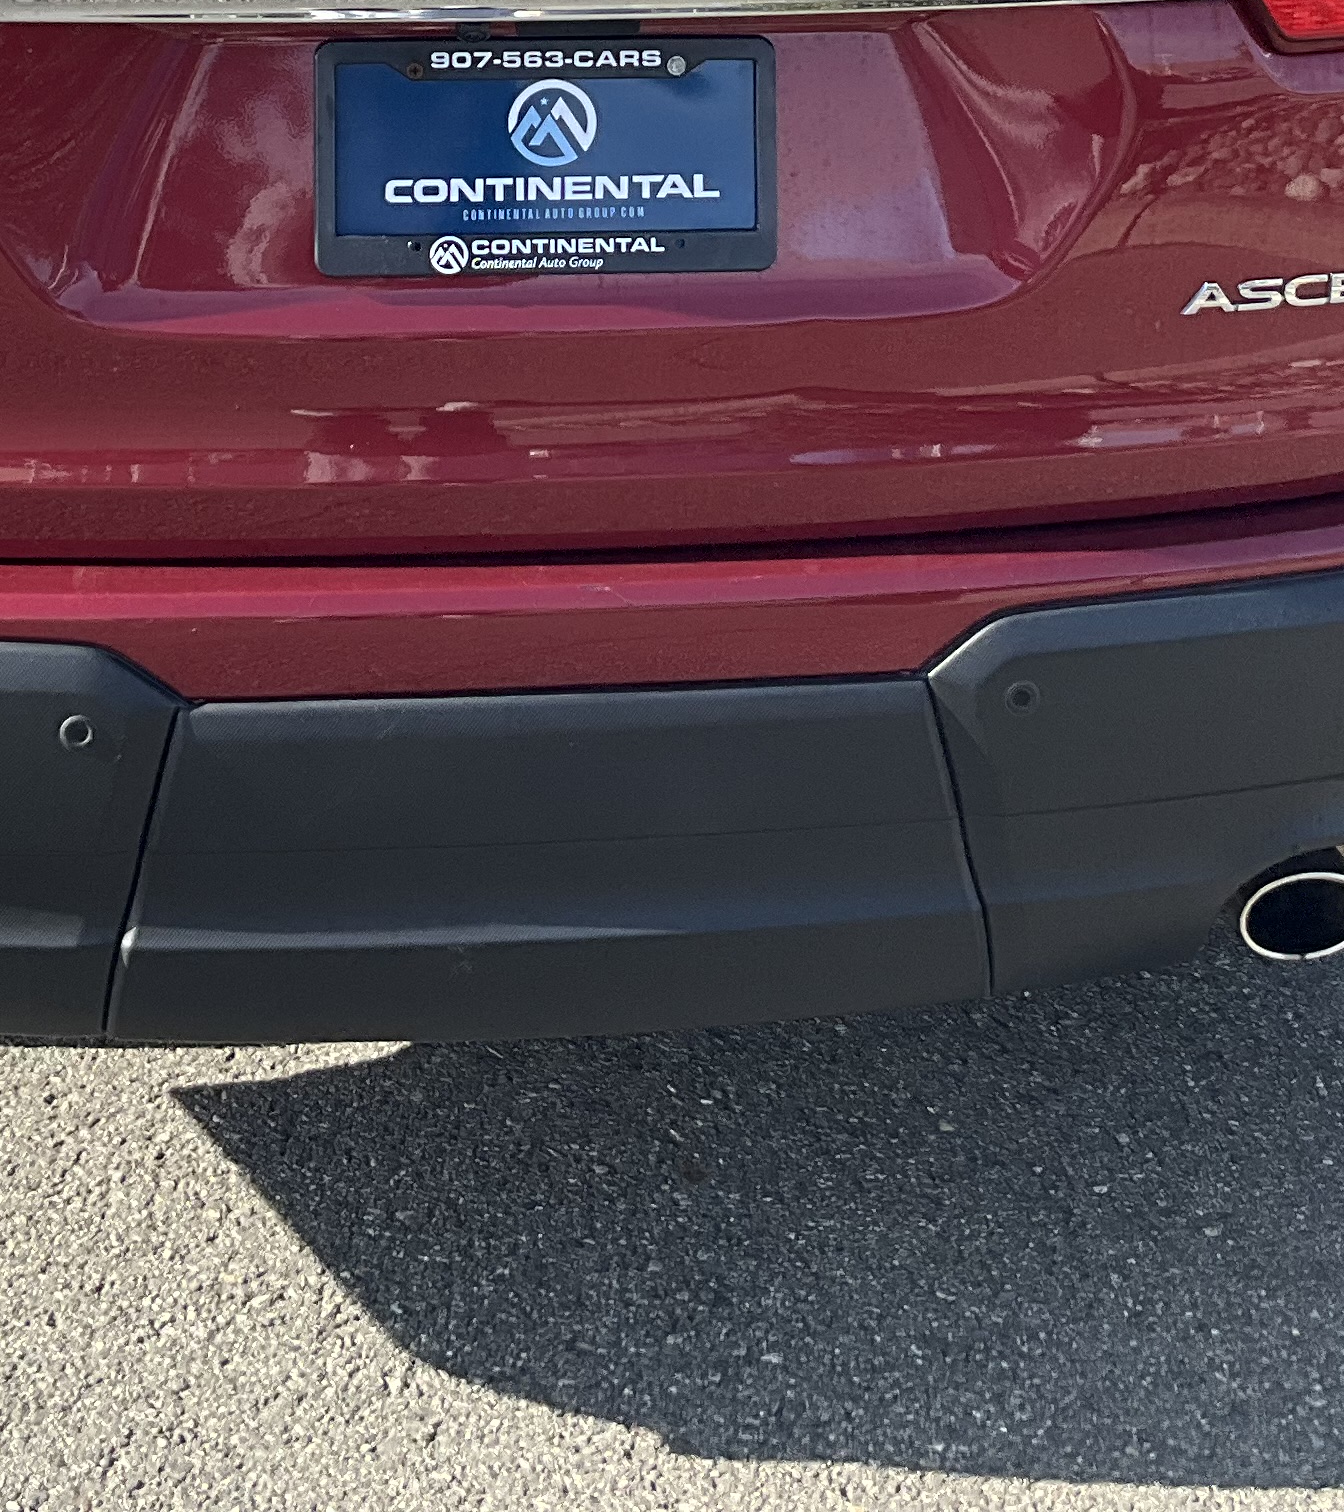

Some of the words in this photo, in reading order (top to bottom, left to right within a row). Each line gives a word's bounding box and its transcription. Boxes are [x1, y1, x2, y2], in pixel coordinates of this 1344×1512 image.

[430, 50, 662, 70] 907-563-CARS
[385, 173, 721, 204] CONTINENTAL
[462, 208, 541, 221] CONTINENTAL
[545, 207, 574, 220] AUTO
[471, 237, 665, 255] CONTINENTAL
[471, 257, 536, 269] Continental
[538, 256, 566, 268] Auto
[569, 256, 604, 271] Group
